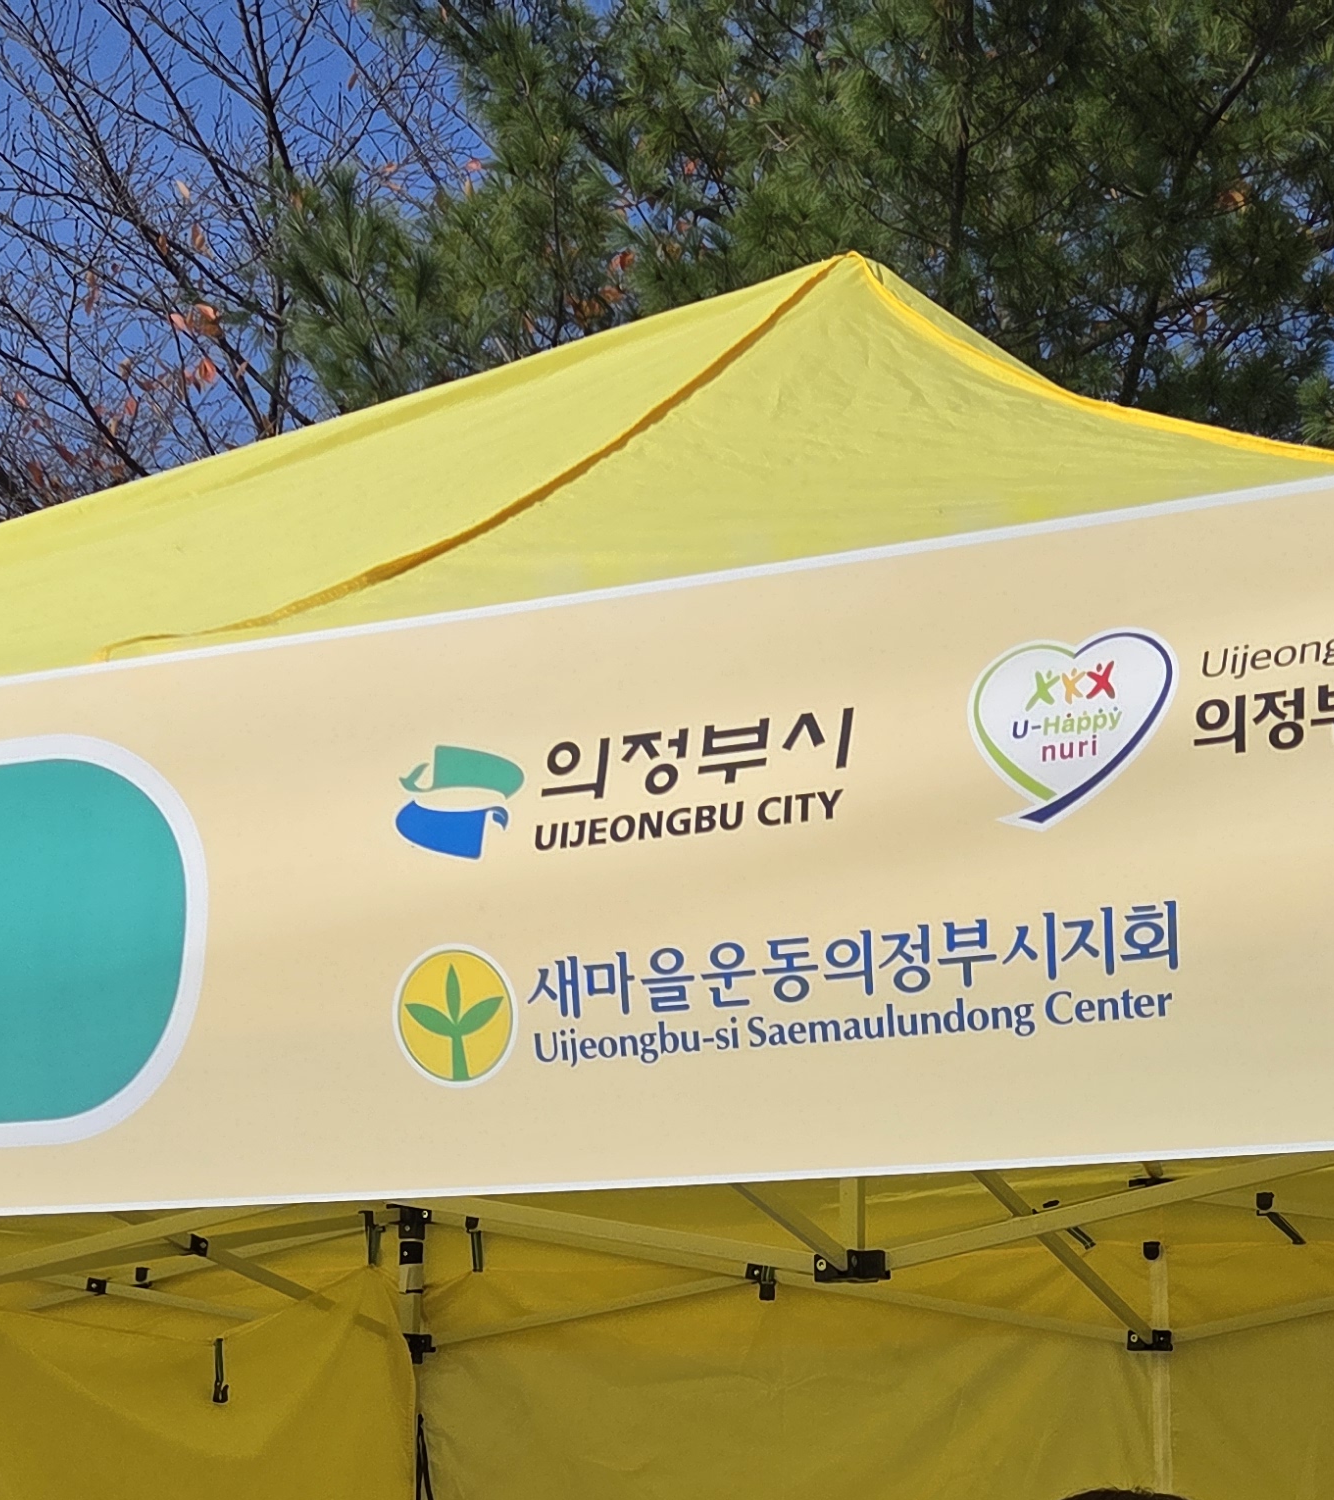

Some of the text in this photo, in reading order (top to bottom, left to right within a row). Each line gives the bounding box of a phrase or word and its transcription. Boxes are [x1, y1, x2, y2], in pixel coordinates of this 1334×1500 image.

[540, 707, 855, 799] 의정부시
[1012, 706, 1122, 739] U-Happy
[1042, 735, 1097, 762] nuri
[534, 788, 843, 851] UIJEONGBU CITY
[528, 900, 1179, 1019] 새마을운동의정부시지회
[534, 990, 1173, 1067] Uijeongbu-si Saemaulundong Center
